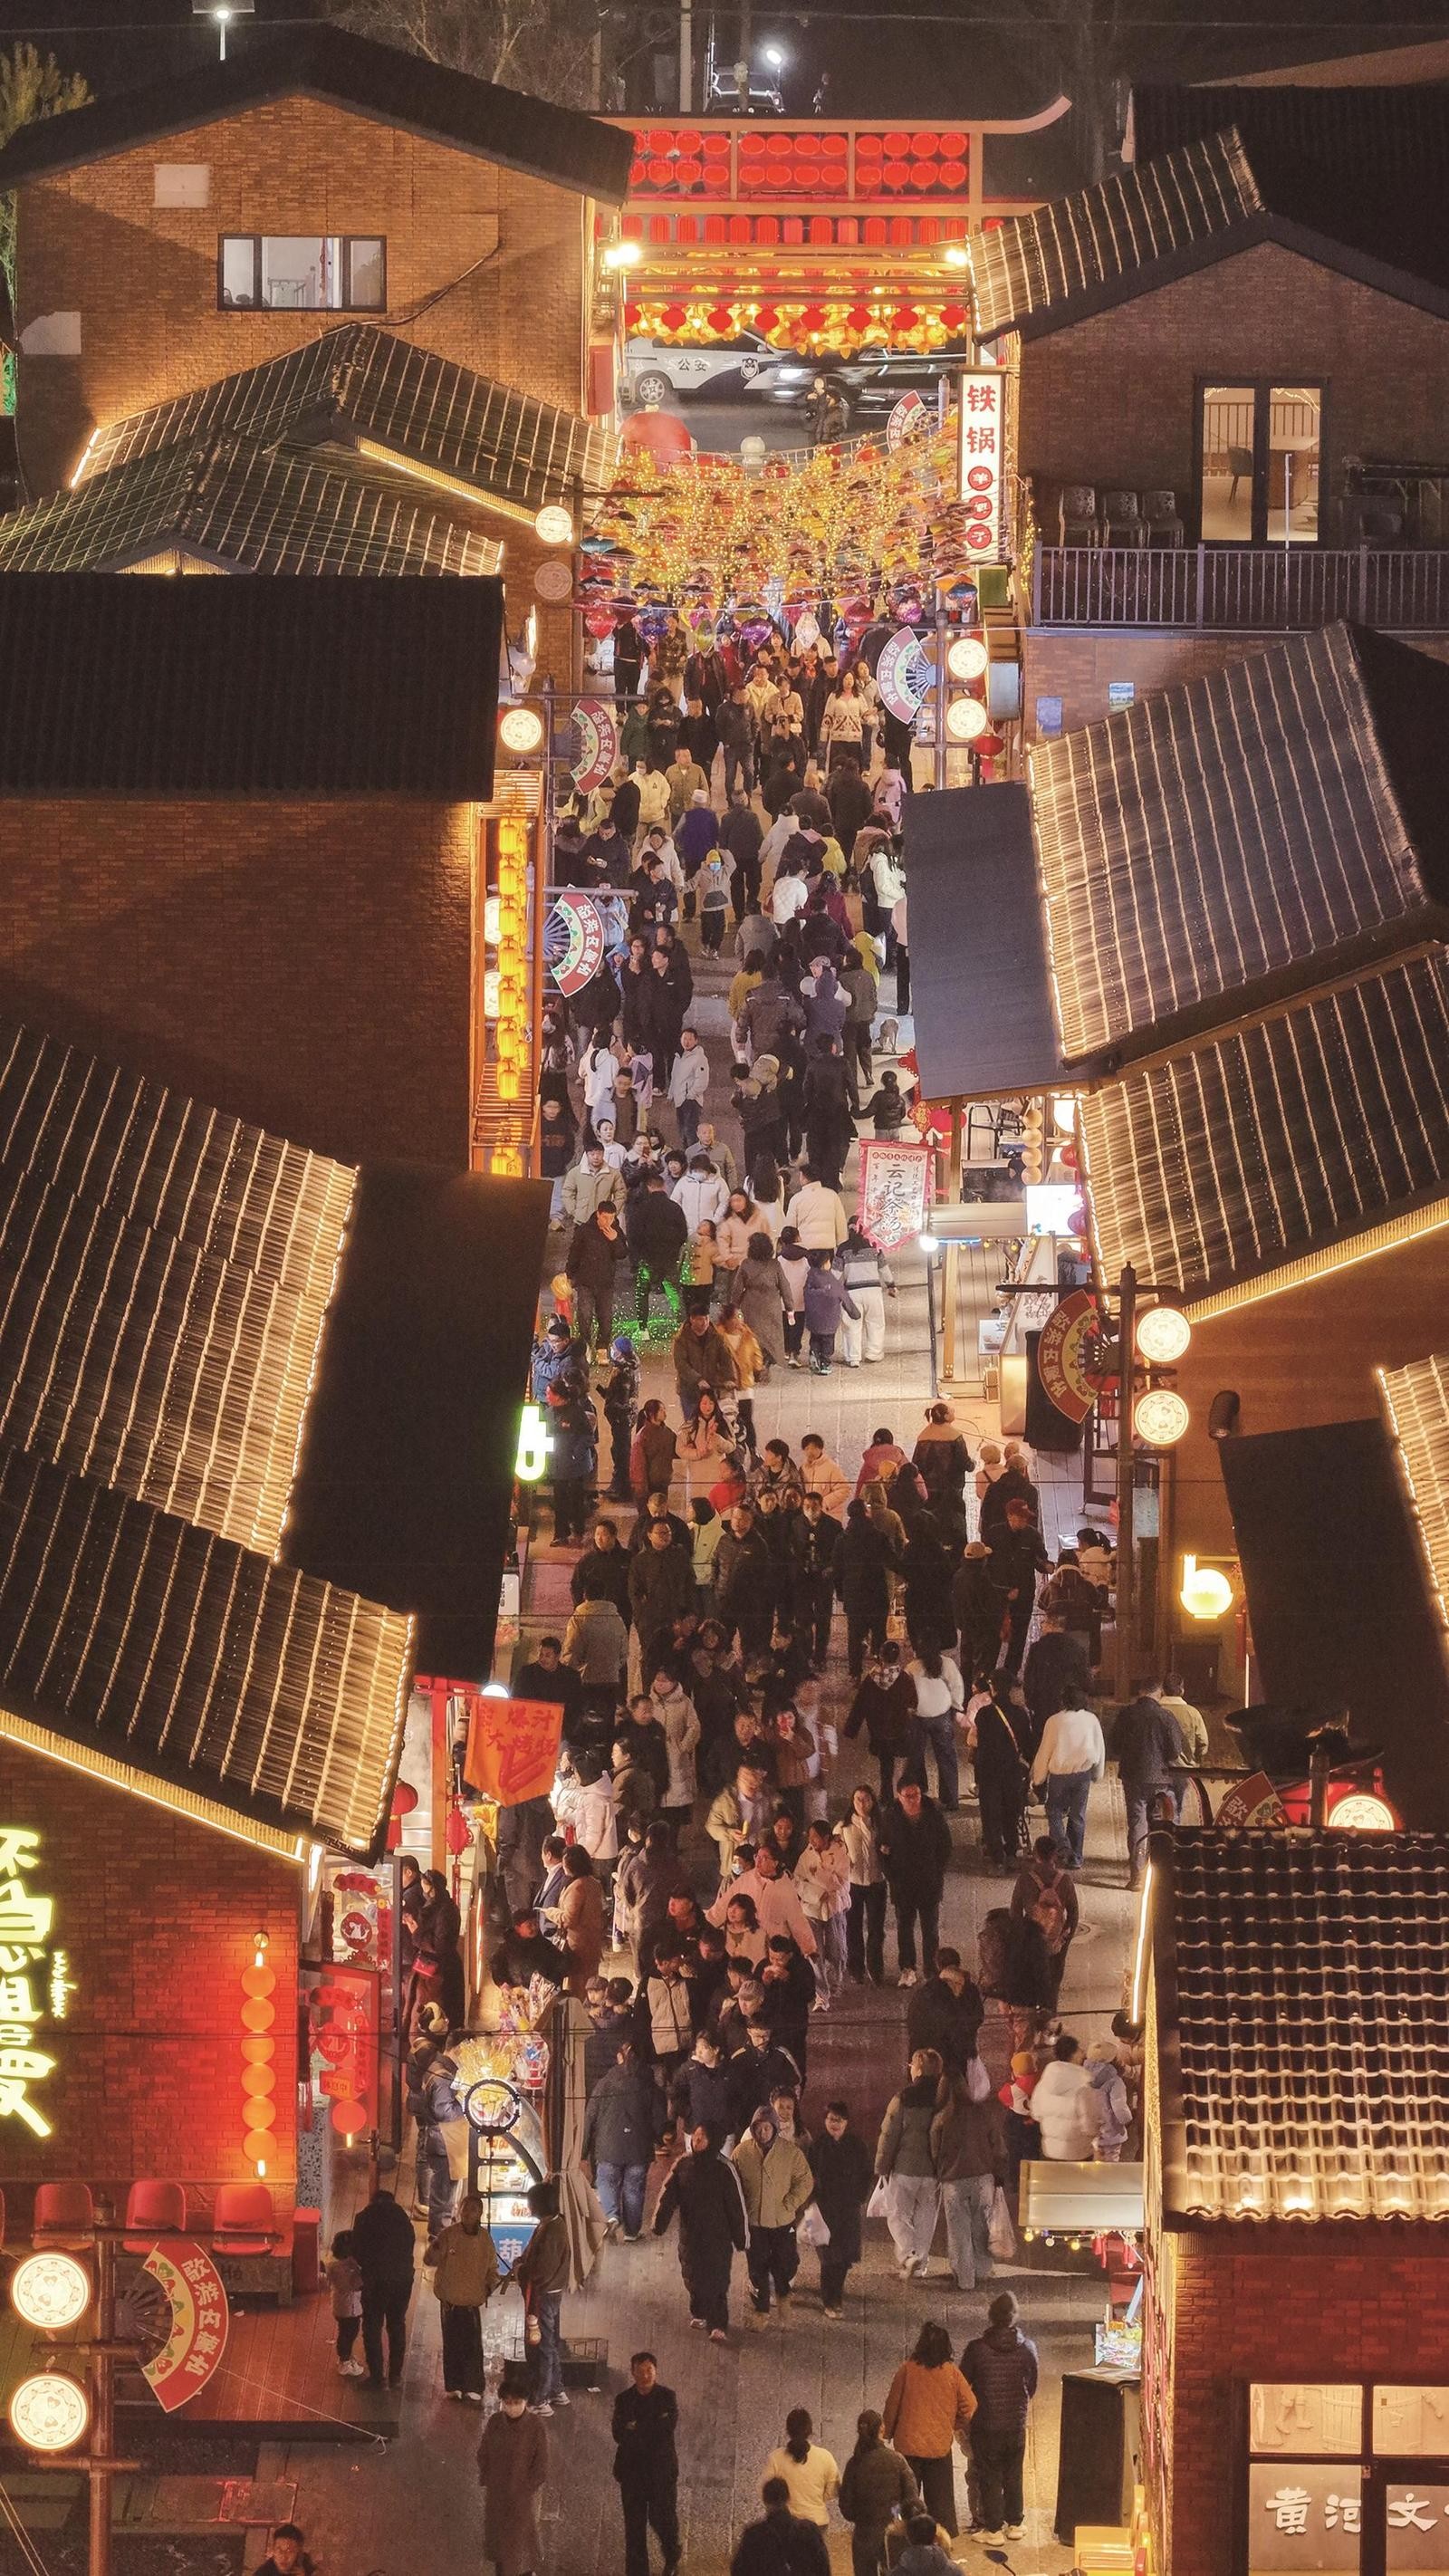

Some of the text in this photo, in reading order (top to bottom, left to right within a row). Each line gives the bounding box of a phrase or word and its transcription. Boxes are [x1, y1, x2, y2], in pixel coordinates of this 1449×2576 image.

[678, 357, 708, 372] 公安
[1265, 2486, 1449, 2534] 黄河文
